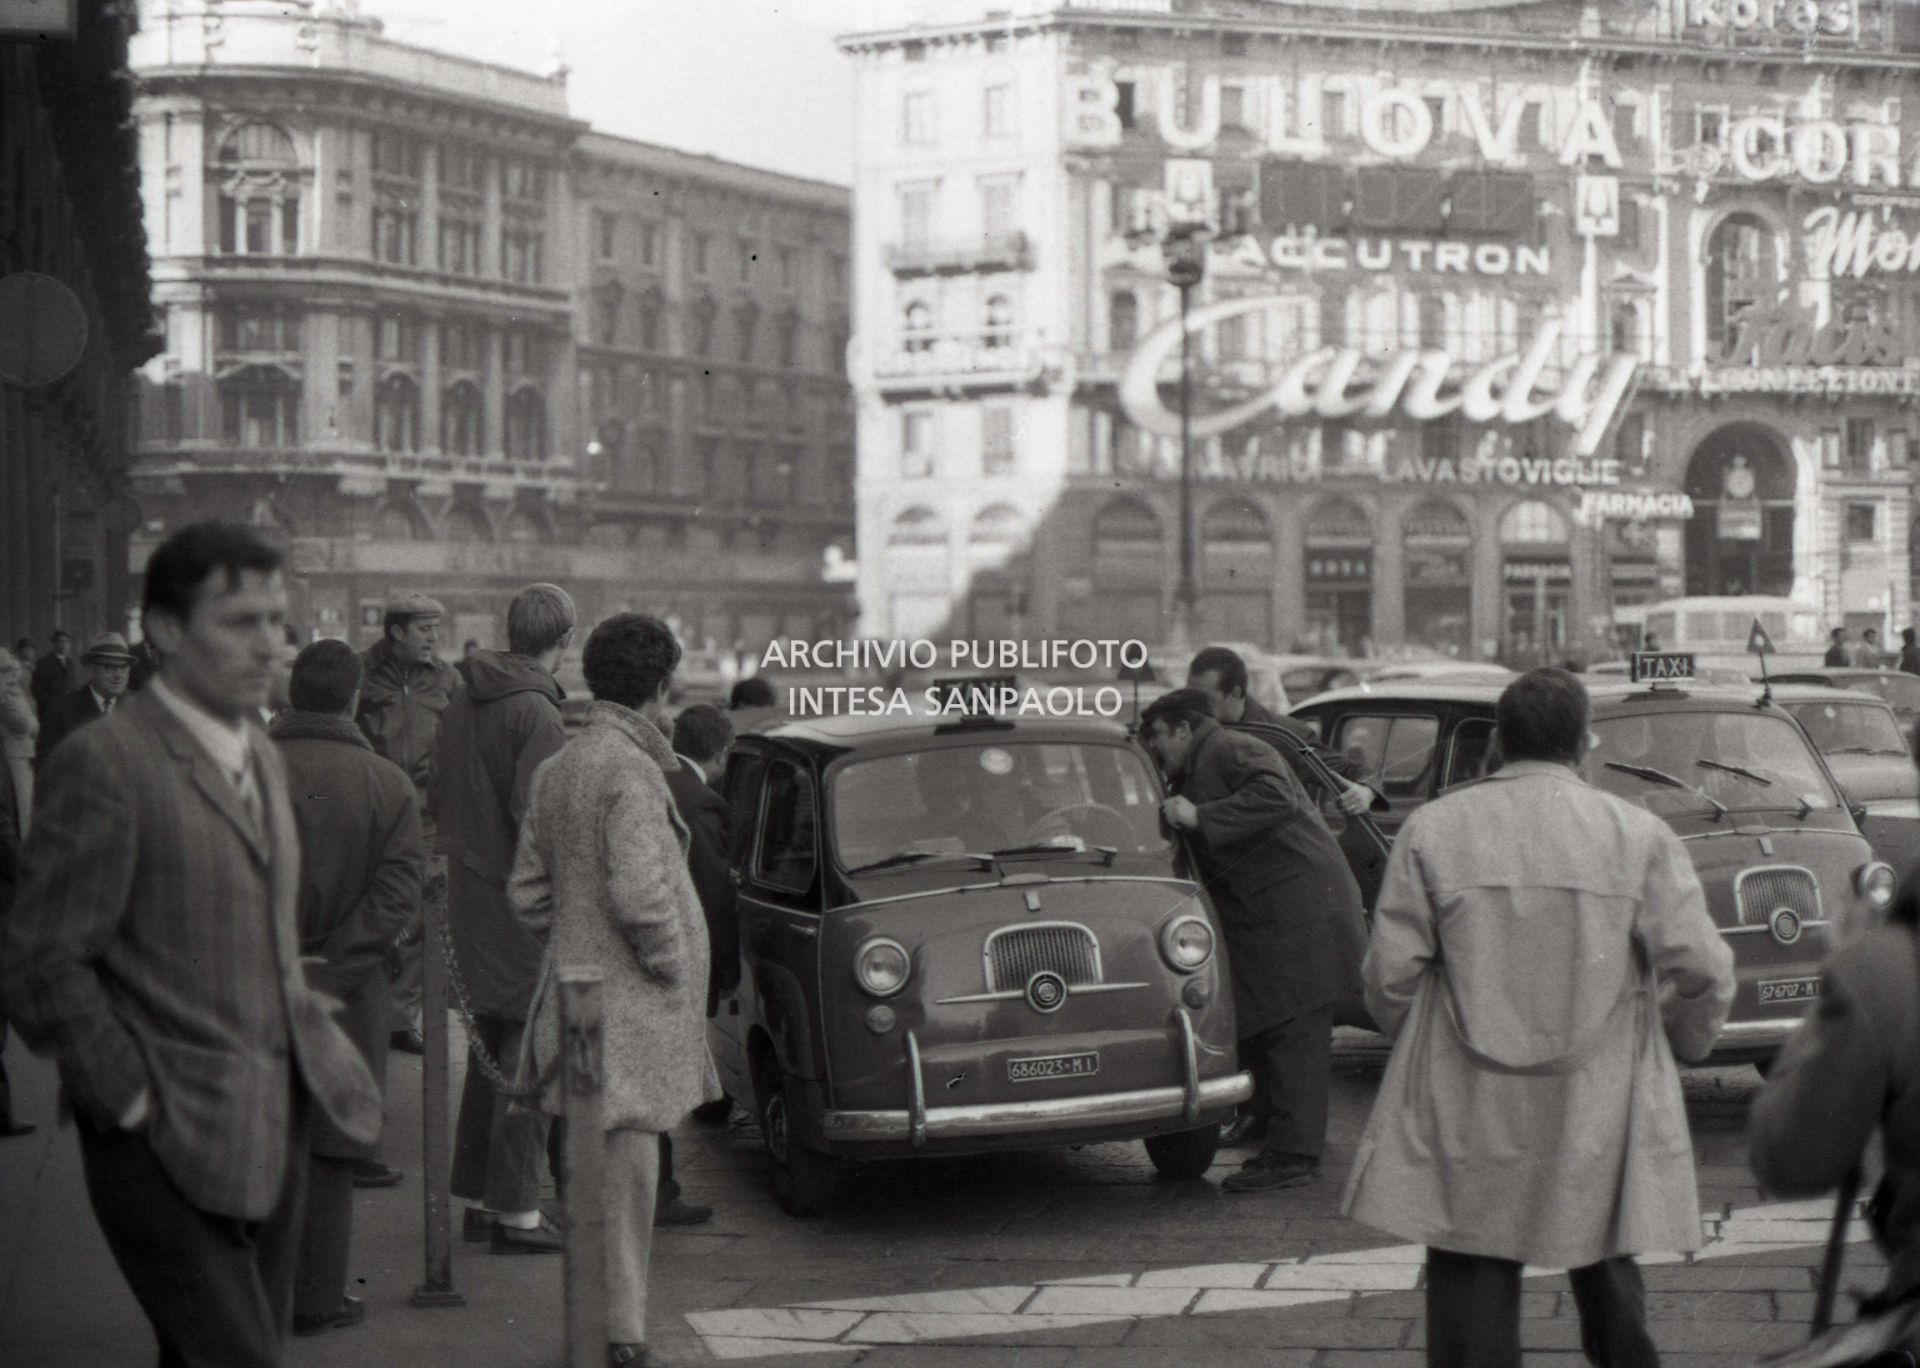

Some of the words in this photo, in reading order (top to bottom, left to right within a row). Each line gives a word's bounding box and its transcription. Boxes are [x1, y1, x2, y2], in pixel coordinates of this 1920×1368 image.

[1062, 74, 1622, 168] BULOVA
[1731, 118, 1920, 188] COR
[1229, 233, 1550, 275] ACCUTRON
[1118, 295, 1641, 457] Candy
[1581, 493, 1694, 520] FARMACIA
[1642, 657, 1688, 678] TAXI
